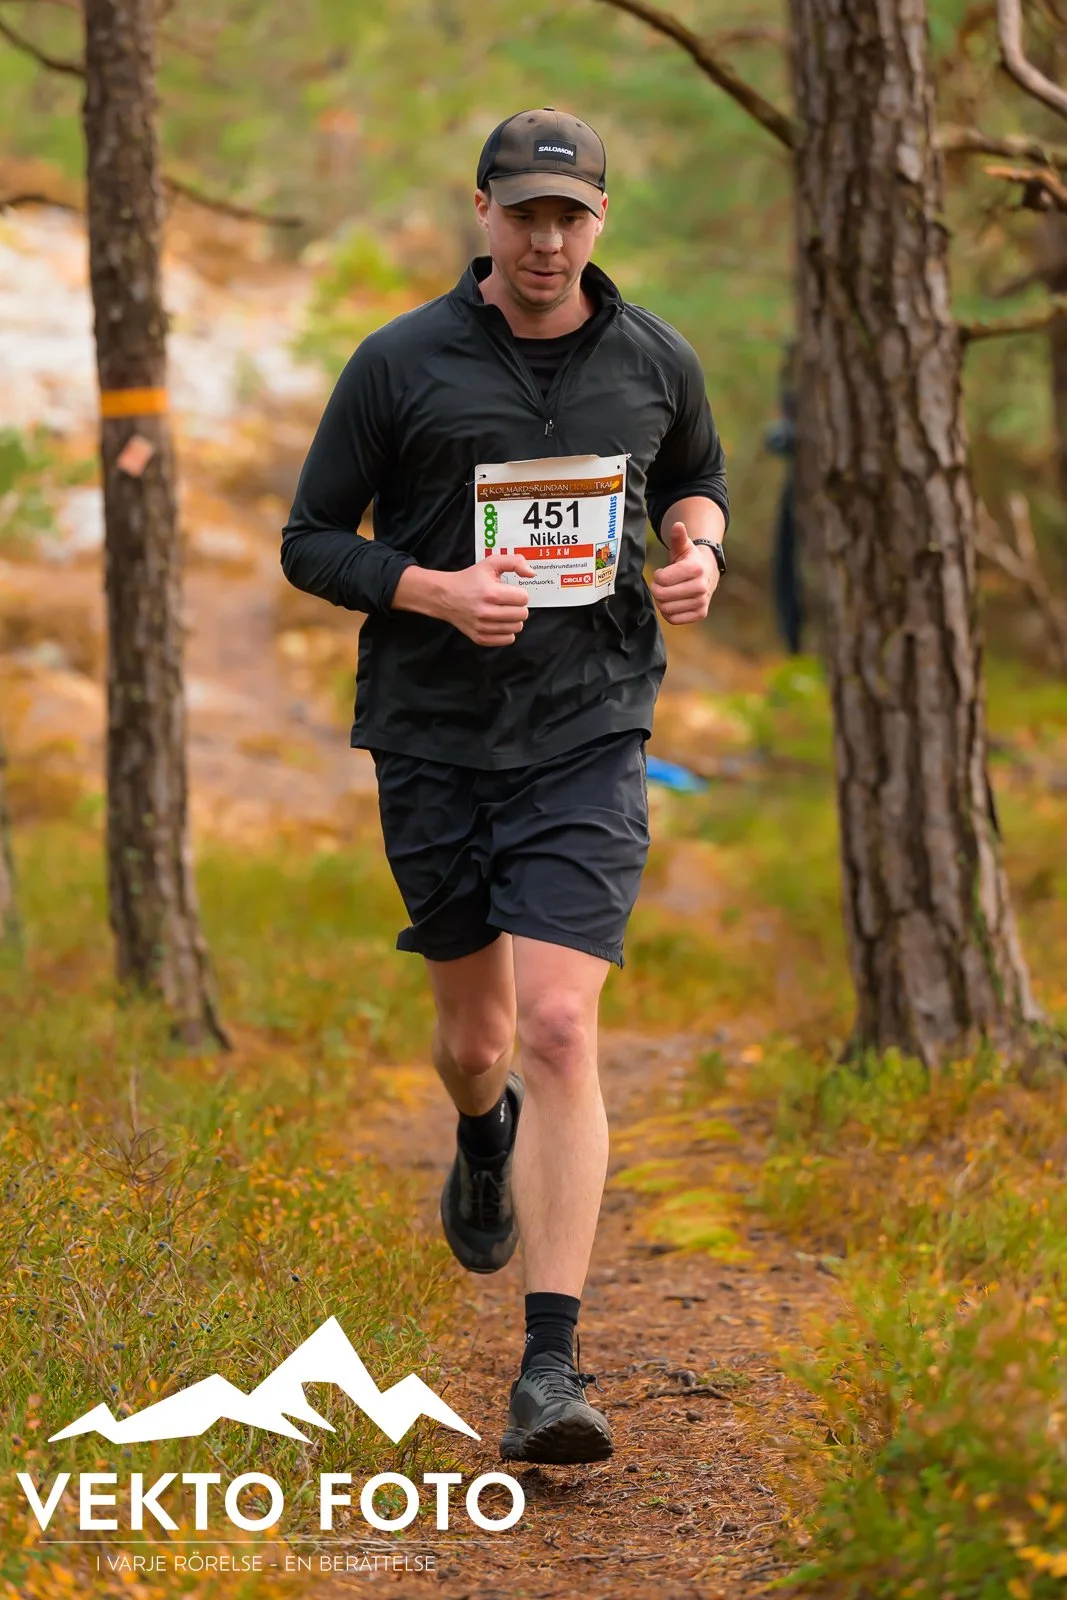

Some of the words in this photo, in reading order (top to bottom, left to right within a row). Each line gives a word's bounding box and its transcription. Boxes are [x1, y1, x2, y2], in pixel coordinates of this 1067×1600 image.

[538, 146, 574, 156] SALOMON
[484, 503, 498, 548] coop
[522, 500, 580, 530] 451
[607, 495, 618, 539] Aktivitus
[530, 532, 579, 546] Niklas
[539, 548, 550, 557] 15
[556, 547, 570, 556] KM
